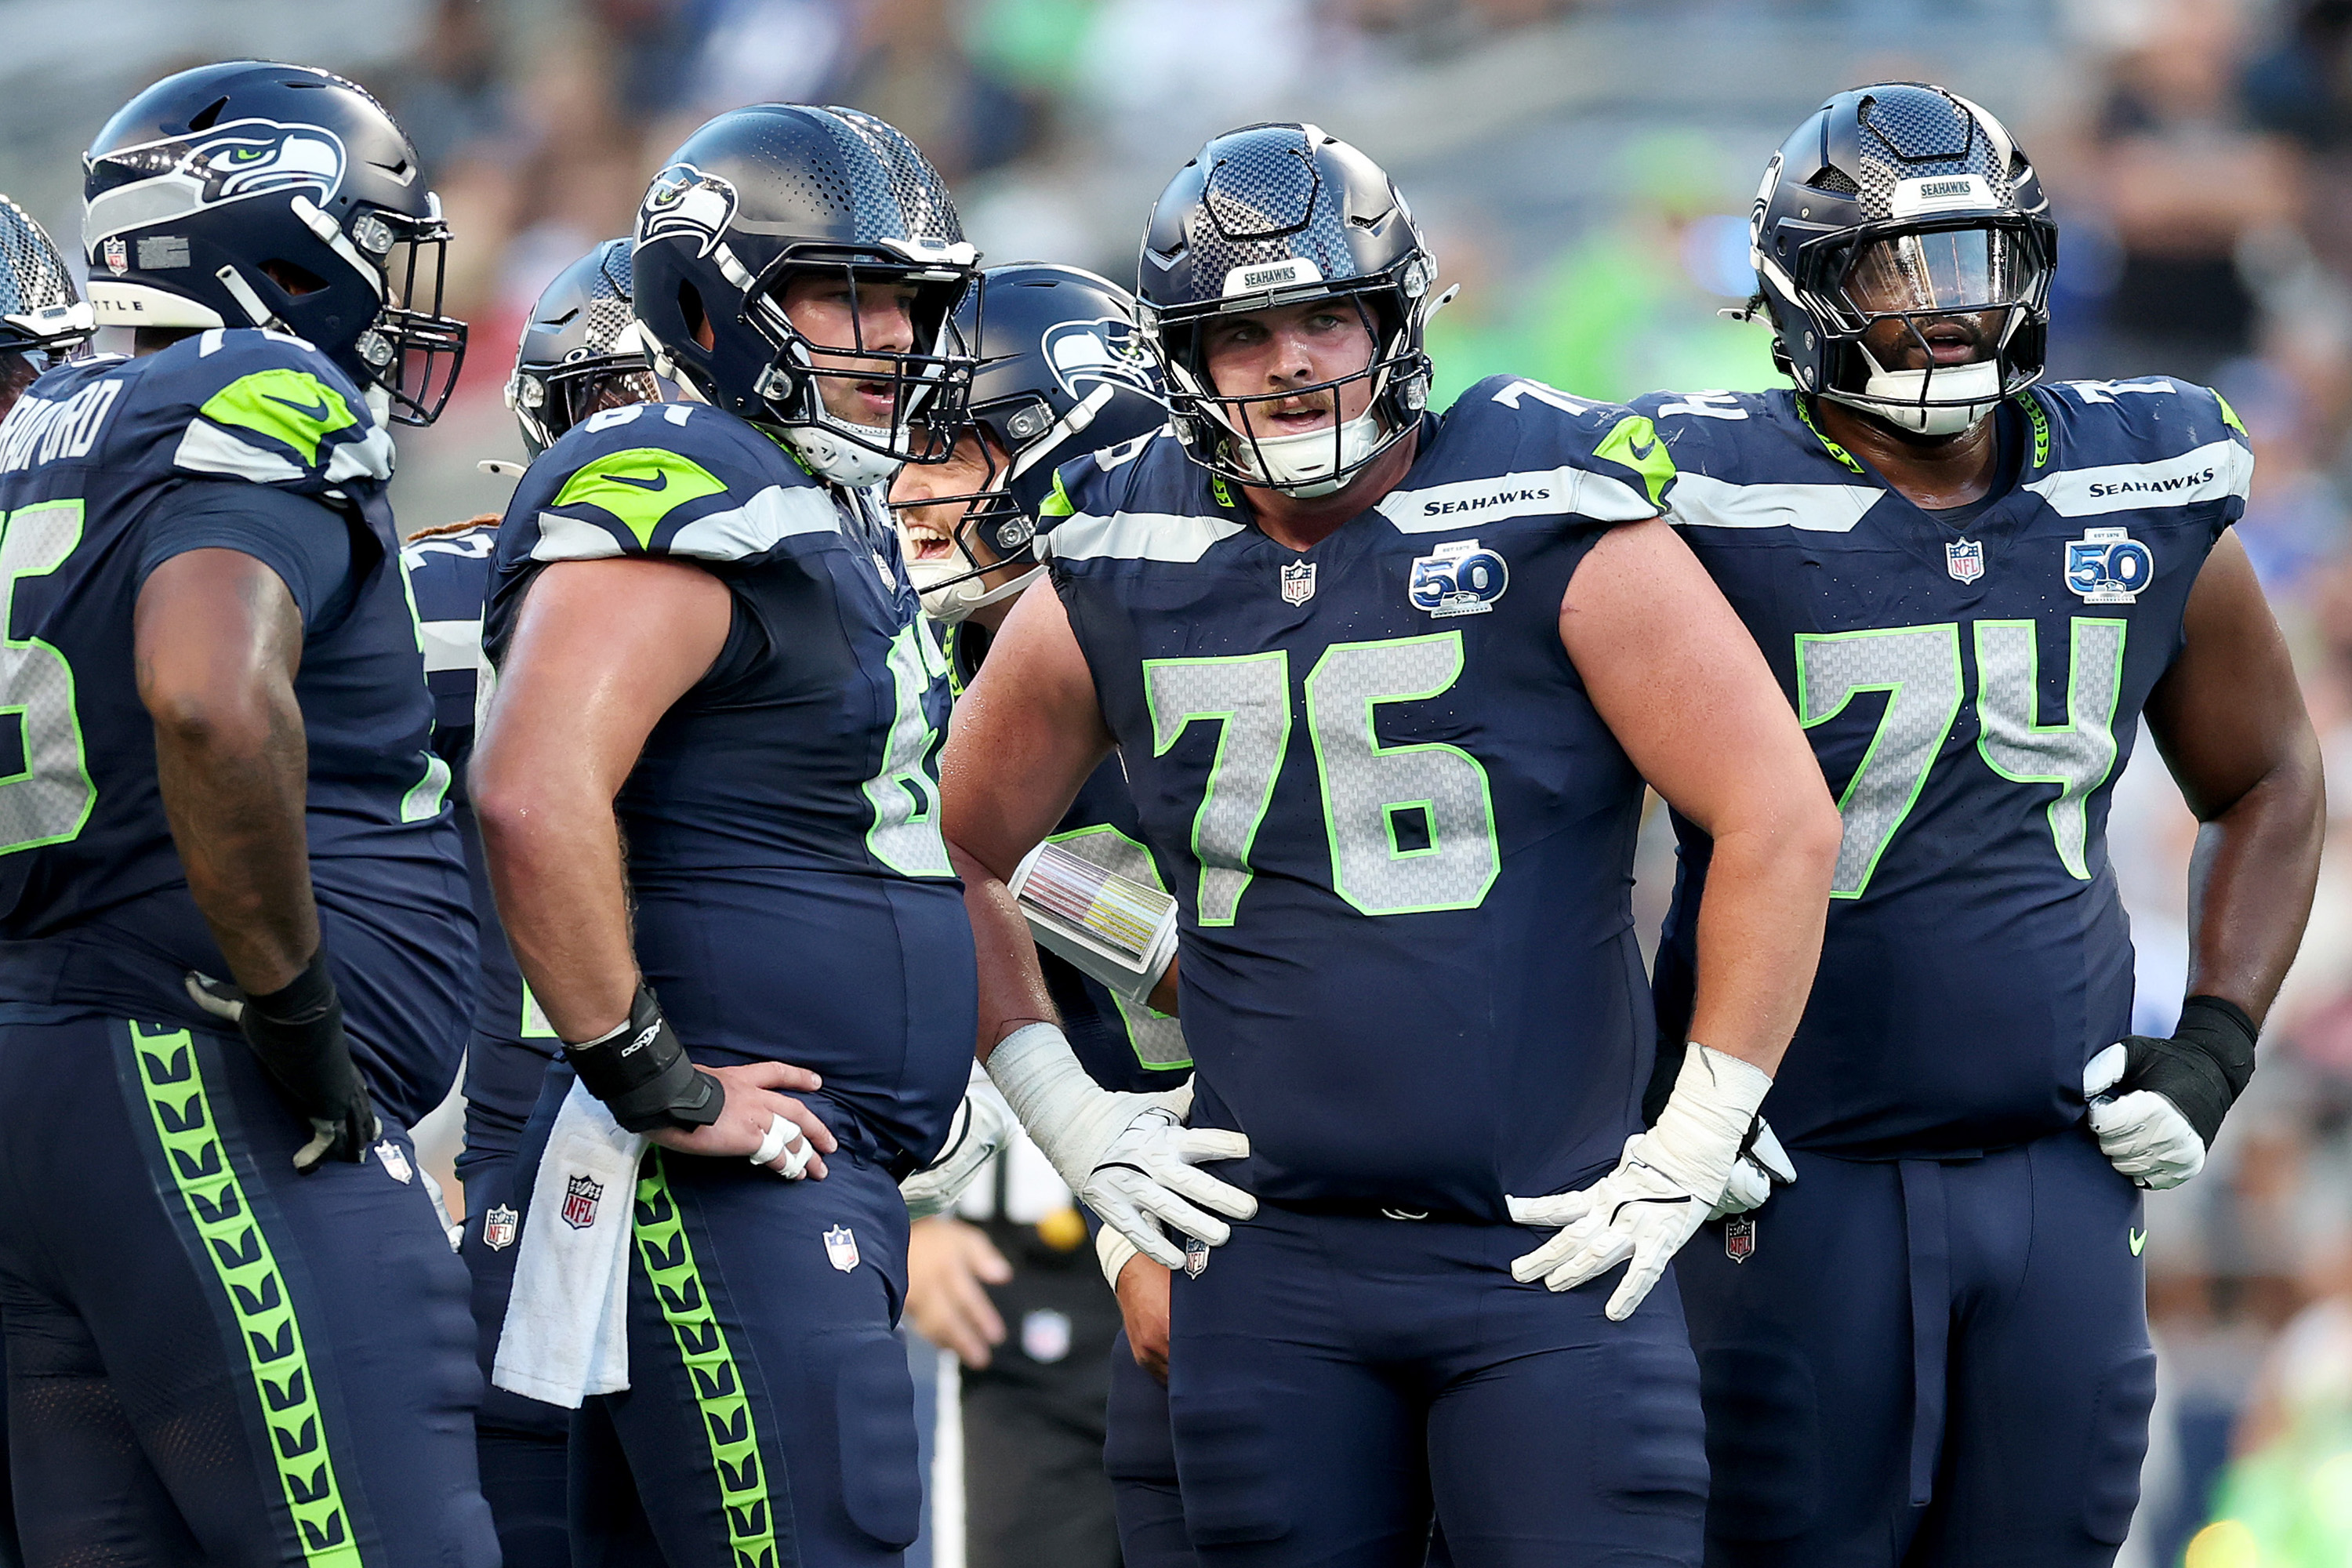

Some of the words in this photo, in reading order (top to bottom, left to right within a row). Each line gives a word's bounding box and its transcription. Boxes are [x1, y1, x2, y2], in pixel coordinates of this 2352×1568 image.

[1921, 181, 1970, 197] SEAHAWKS
[1244, 267, 1296, 287] SEAHAWKS
[2089, 468, 2214, 498] SEAHAWKS
[1424, 488, 1550, 517] SEAHAWKS
[1413, 554, 1505, 608] 50
[1954, 558, 1978, 575] NFL
[2069, 543, 2150, 592] 50
[1287, 580, 1308, 597] NFL
[1795, 616, 2128, 900] 74
[1142, 630, 1501, 927] 76
[564, 1195, 593, 1224] NFL
[488, 1225, 510, 1242] NFL
